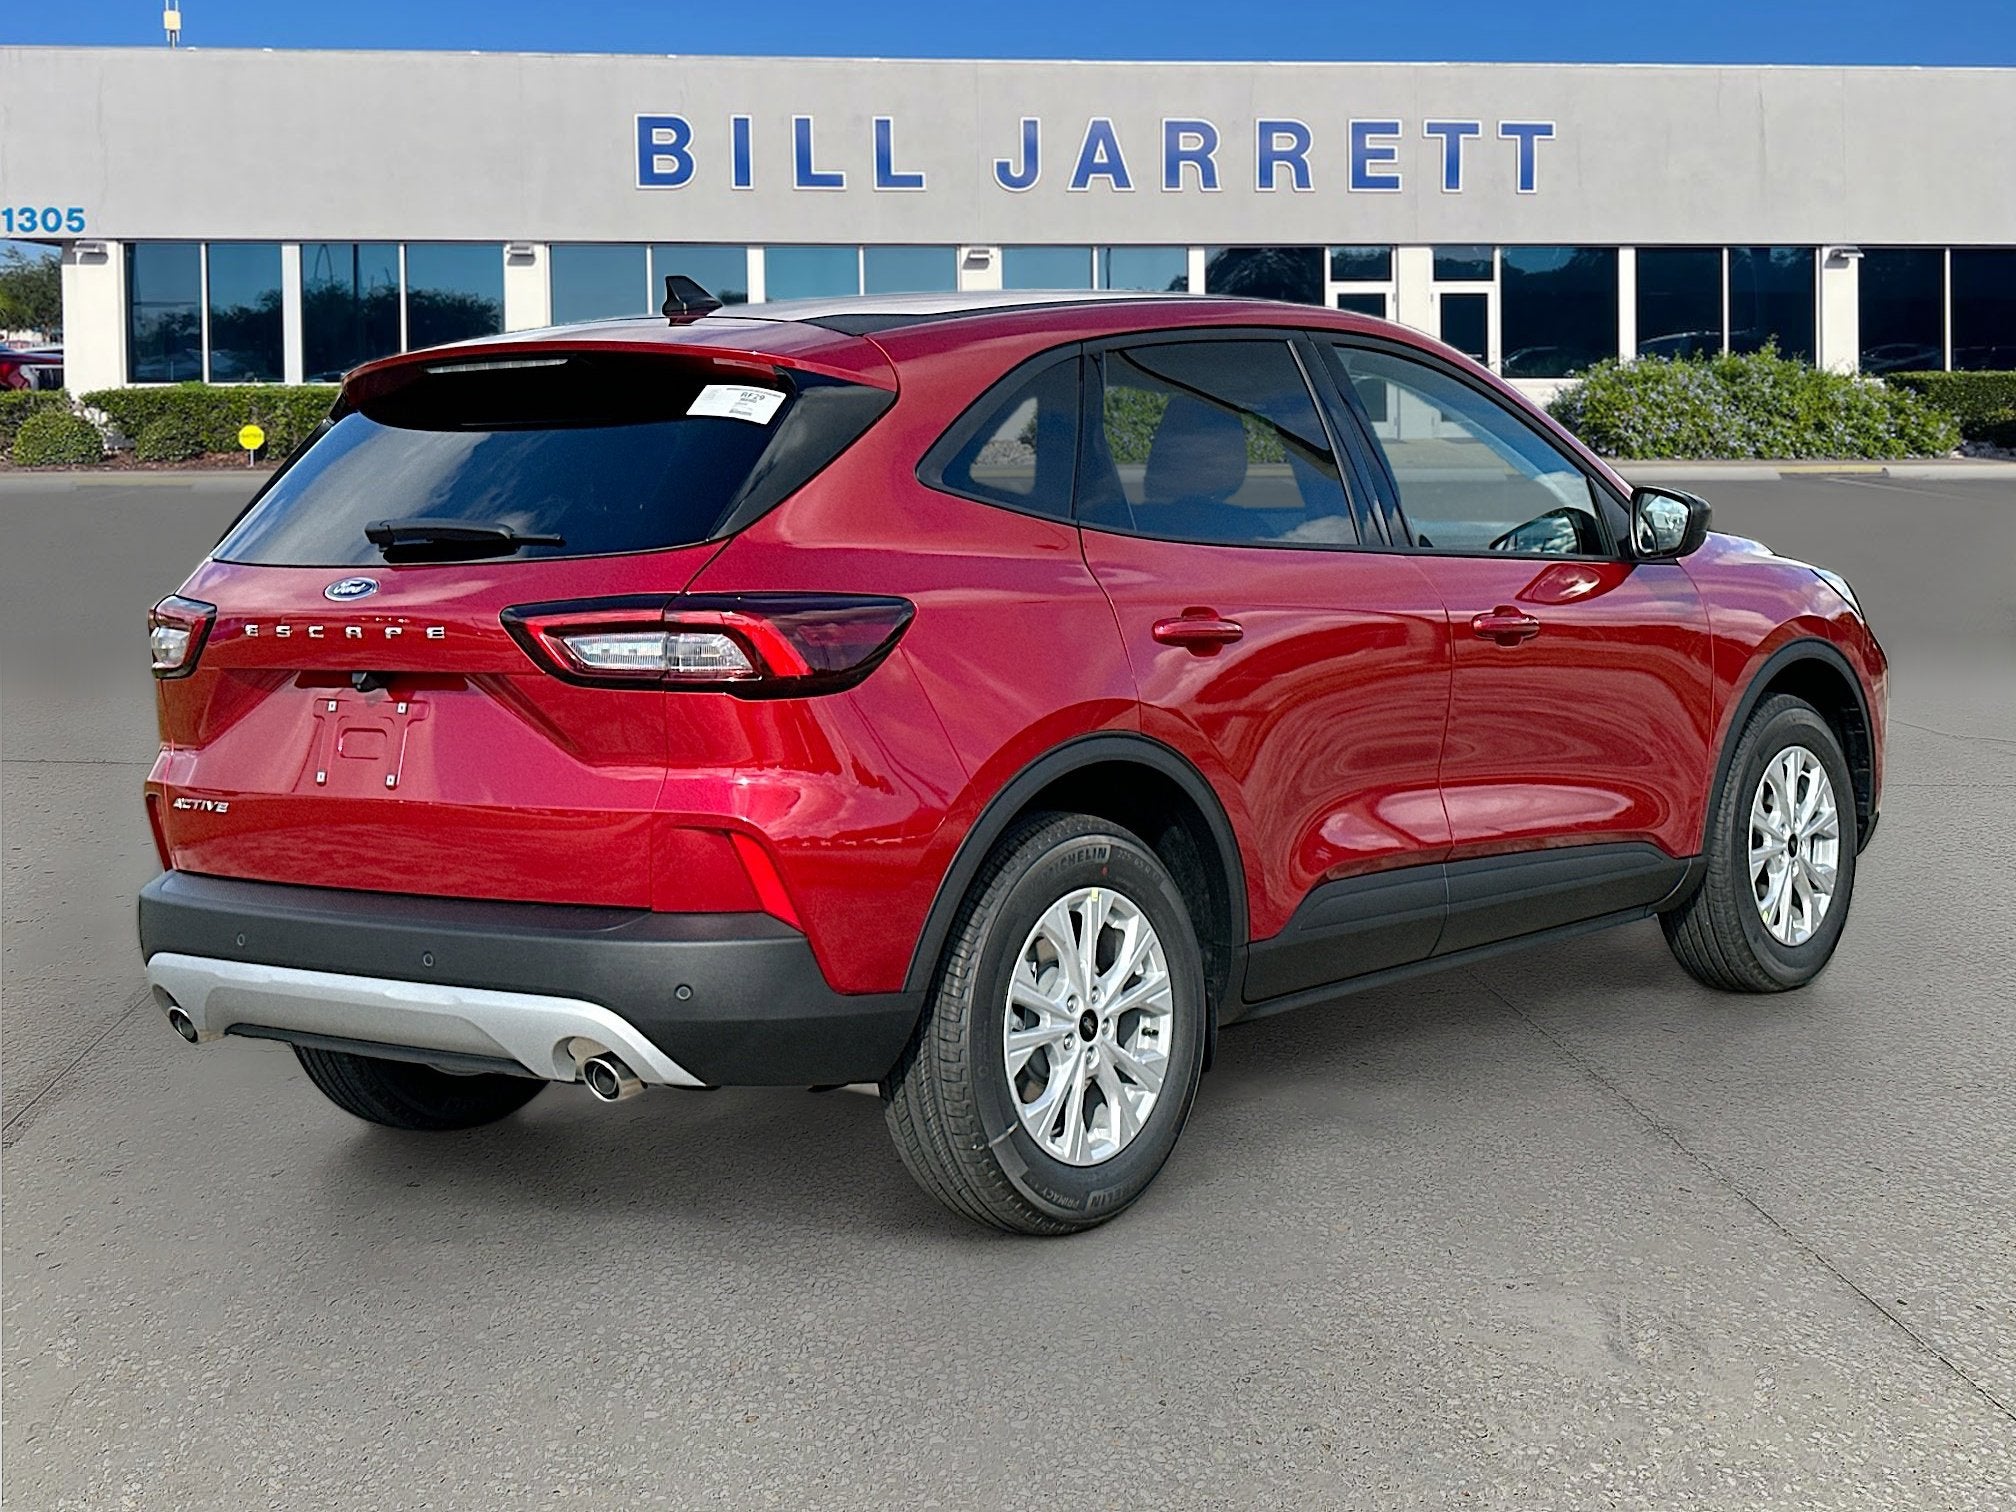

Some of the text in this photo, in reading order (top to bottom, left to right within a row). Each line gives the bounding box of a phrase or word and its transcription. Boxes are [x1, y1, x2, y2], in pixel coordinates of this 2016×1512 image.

[634, 114, 1556, 194] BILL JARRETT
[2, 206, 86, 233] 1305
[244, 623, 446, 639] ESCAPE
[173, 797, 230, 813] ACTIVE
